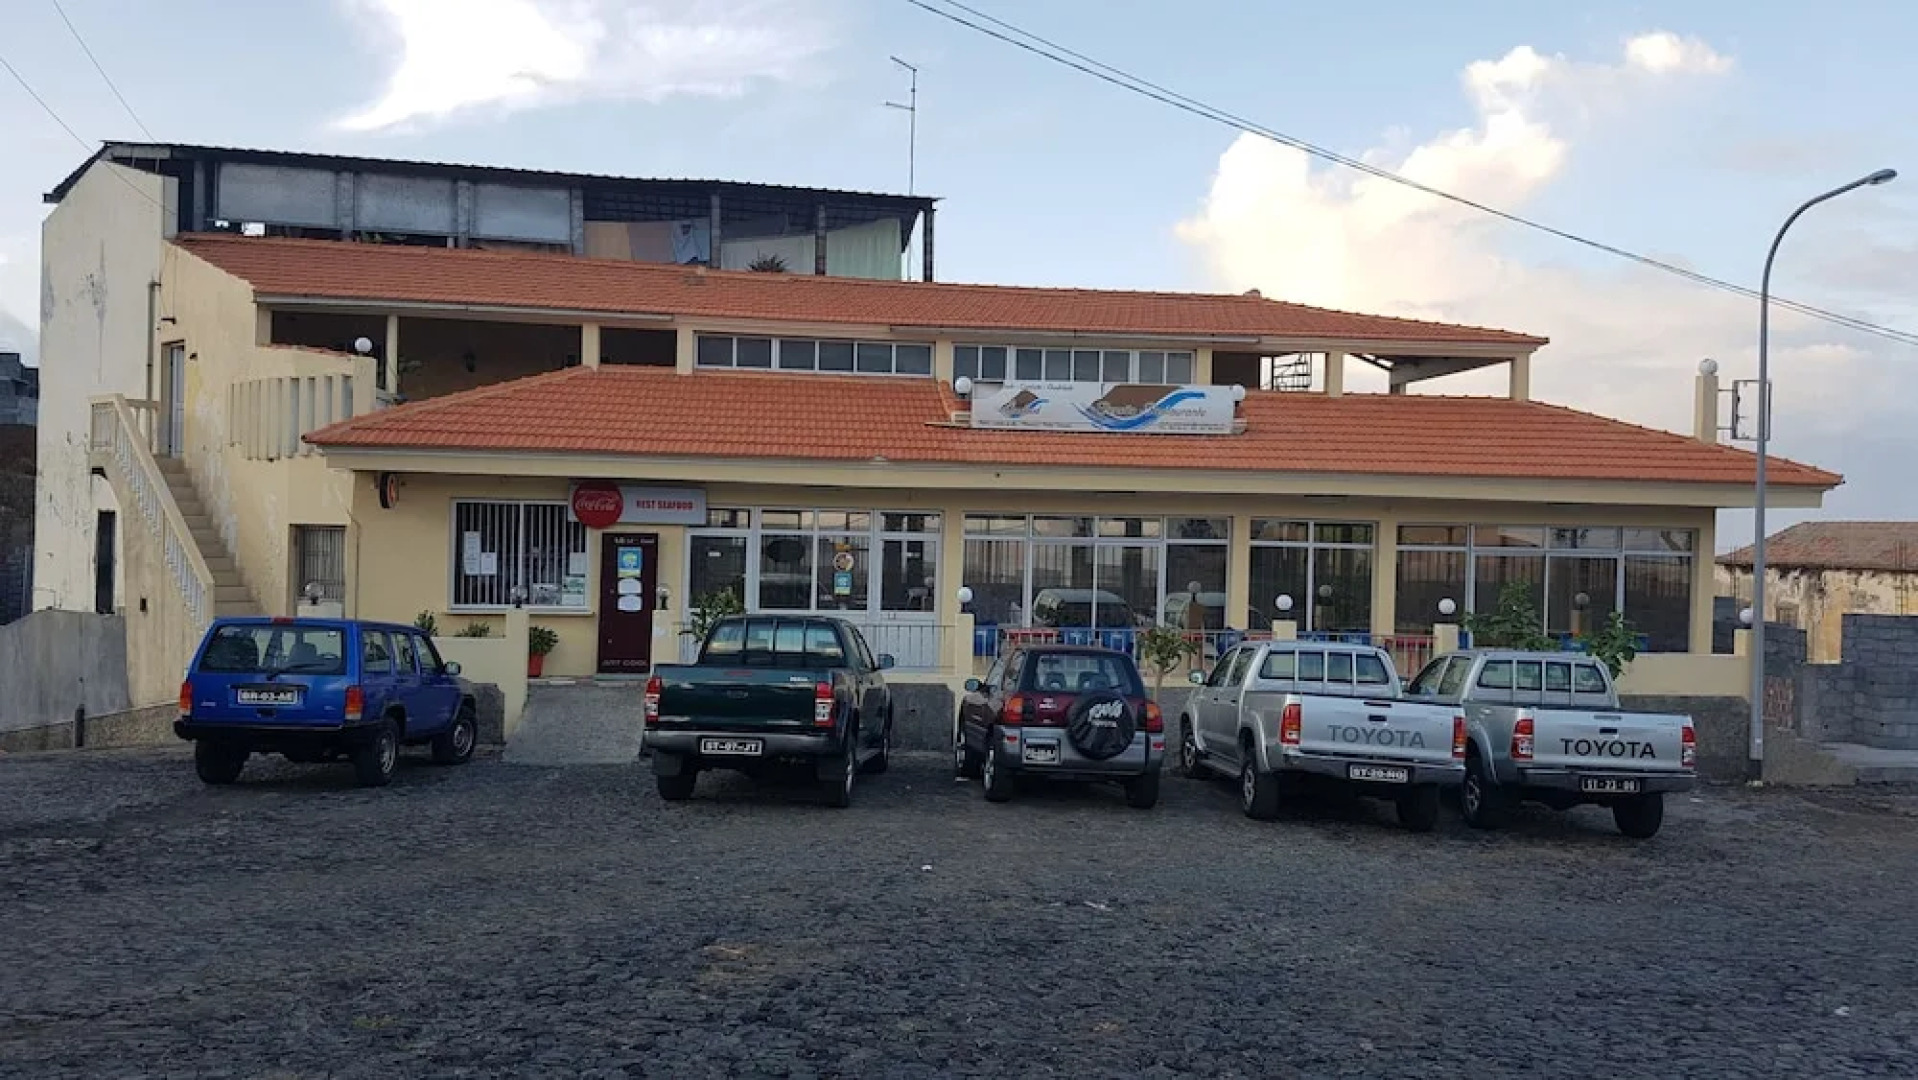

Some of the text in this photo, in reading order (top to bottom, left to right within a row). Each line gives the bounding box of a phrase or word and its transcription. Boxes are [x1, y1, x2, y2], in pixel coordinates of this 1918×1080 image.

[657, 500, 693, 511] SEAFOOD
[1327, 724, 1426, 748] TOYOTA
[1559, 738, 1656, 758] TOYOTA
